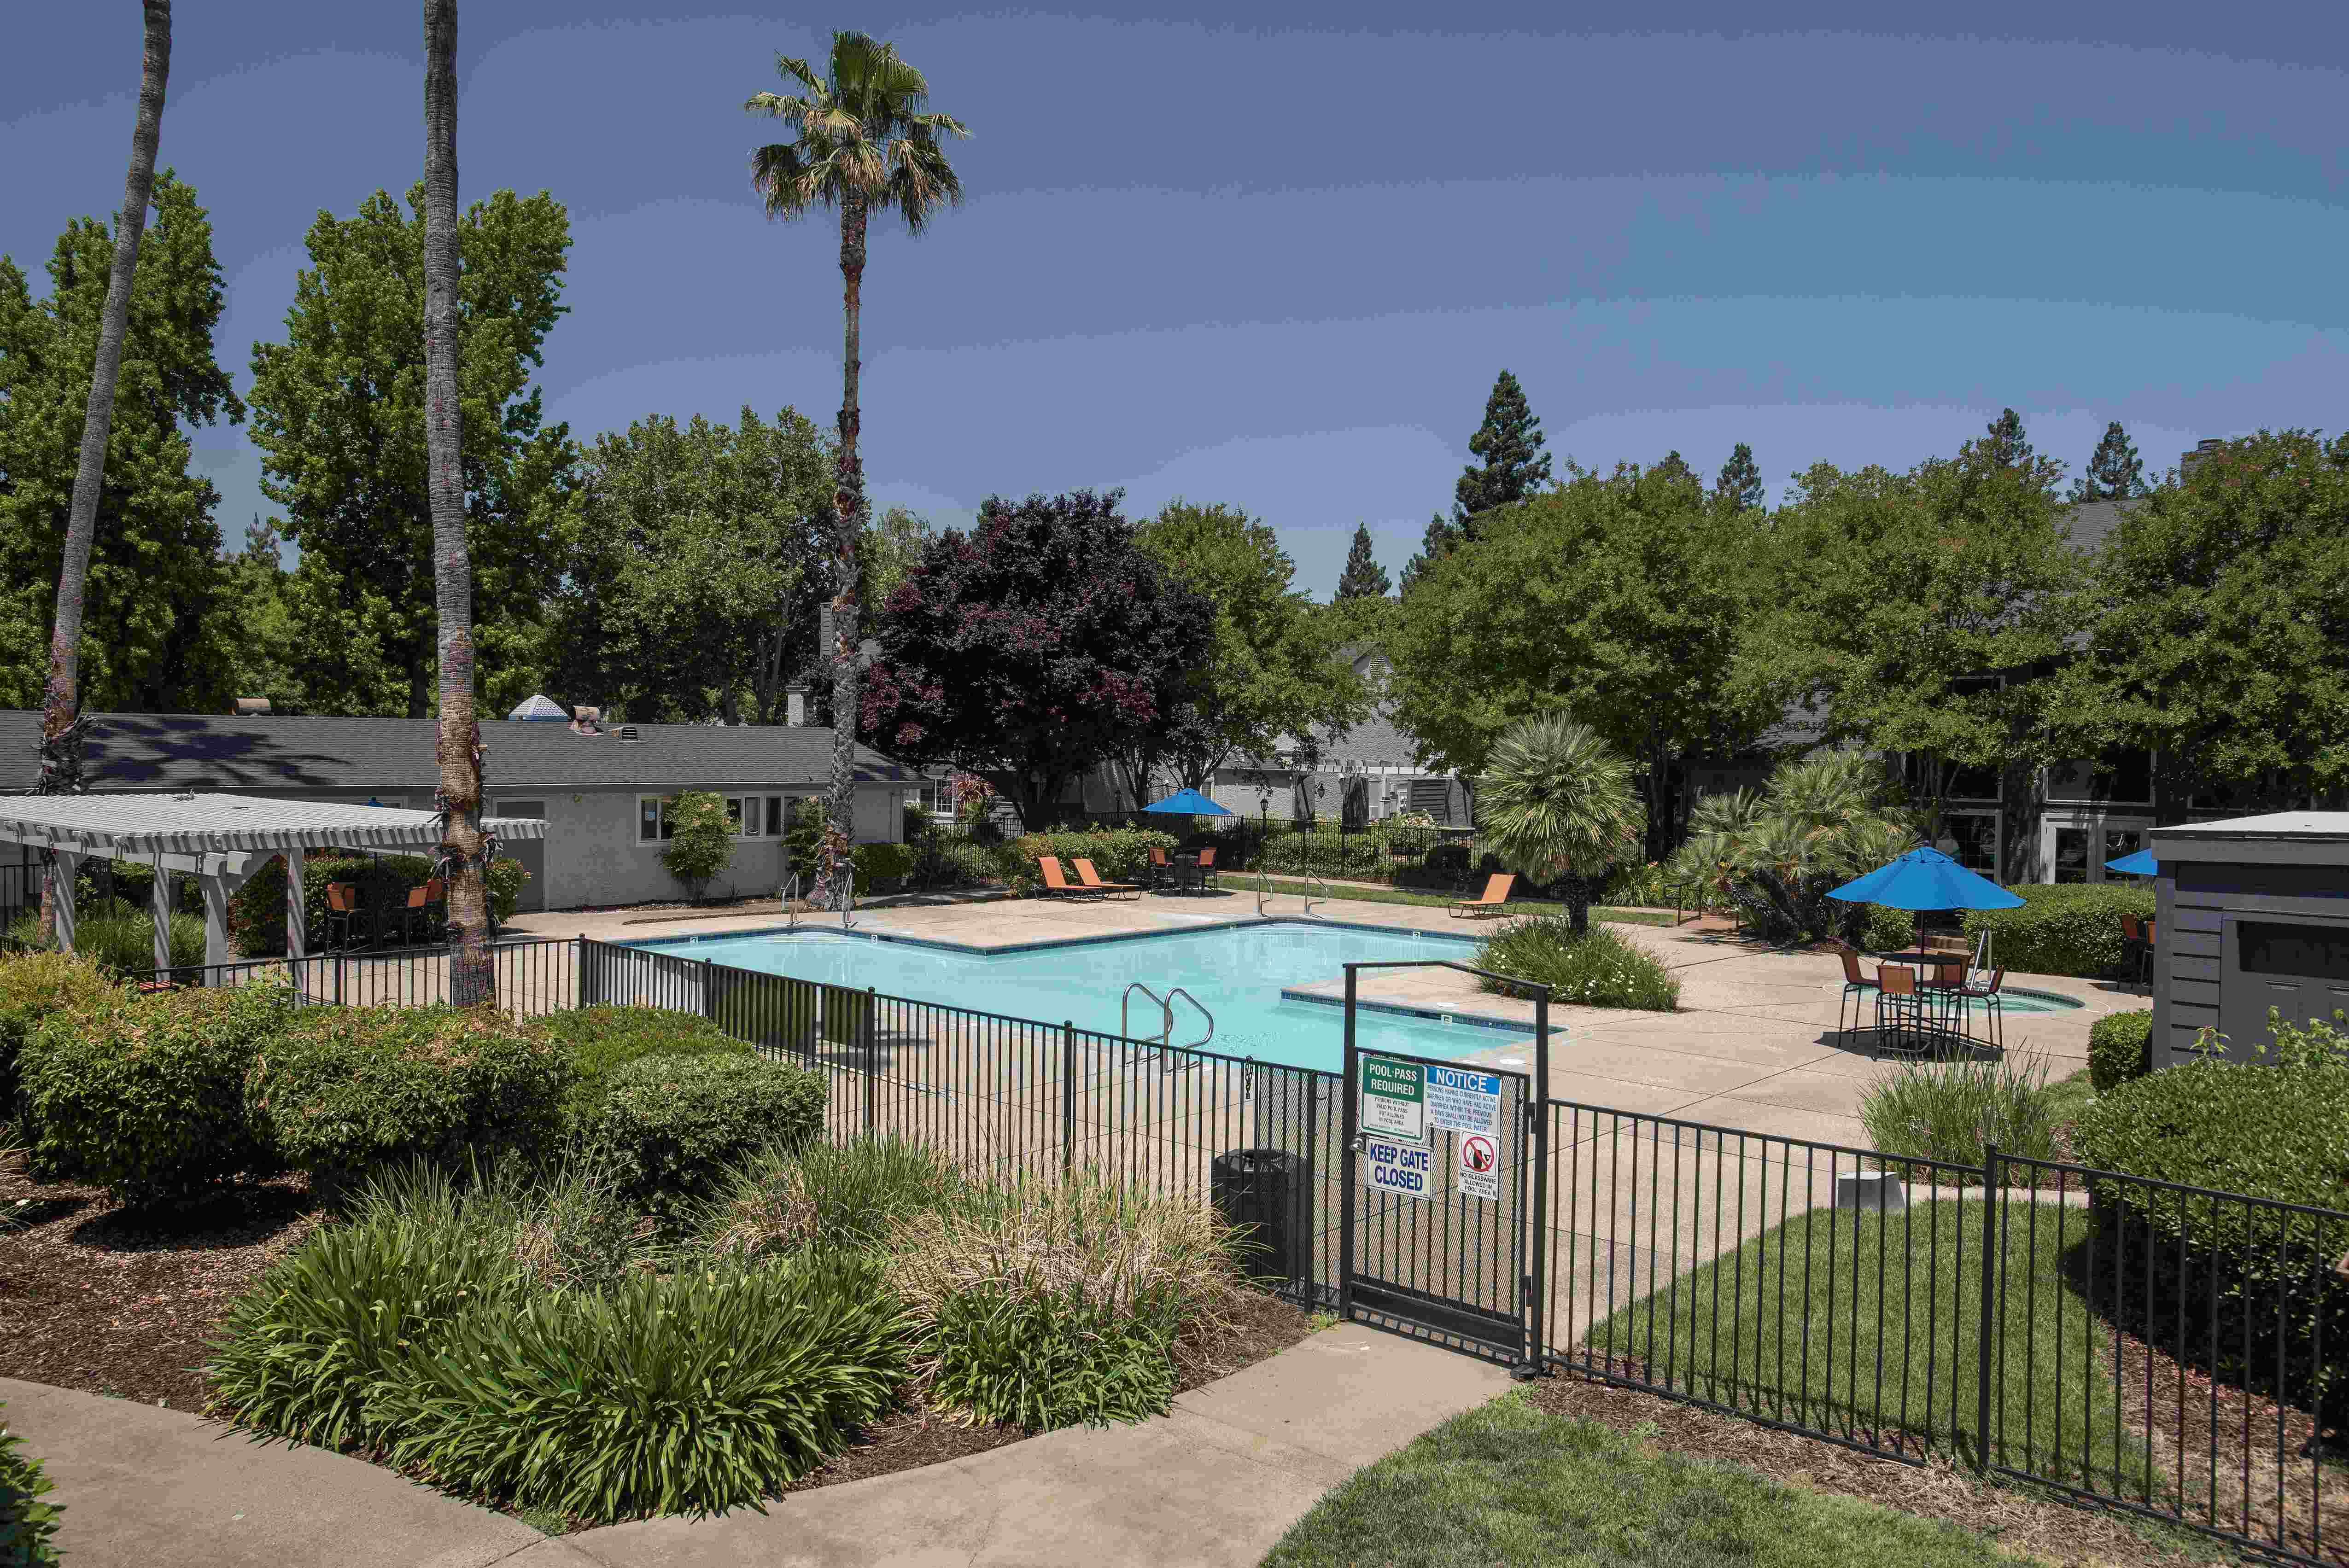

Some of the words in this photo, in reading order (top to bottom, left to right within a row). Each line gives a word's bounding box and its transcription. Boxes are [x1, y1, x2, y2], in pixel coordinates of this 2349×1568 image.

[1370, 1063, 1392, 1077] POOL
[1395, 1068, 1417, 1081] PASS
[1437, 1068, 1487, 1092] NOTICE
[1371, 1078, 1414, 1095] REQUIRED
[1474, 1117, 1492, 1126] ALLOWED
[1370, 1143, 1397, 1165] KEEP
[1400, 1148, 1428, 1171] GATE
[1375, 1165, 1423, 1191] CLOSED
[1464, 1179, 1486, 1188] ALLOWED
[1468, 1174, 1496, 1184] GLASSWARE
